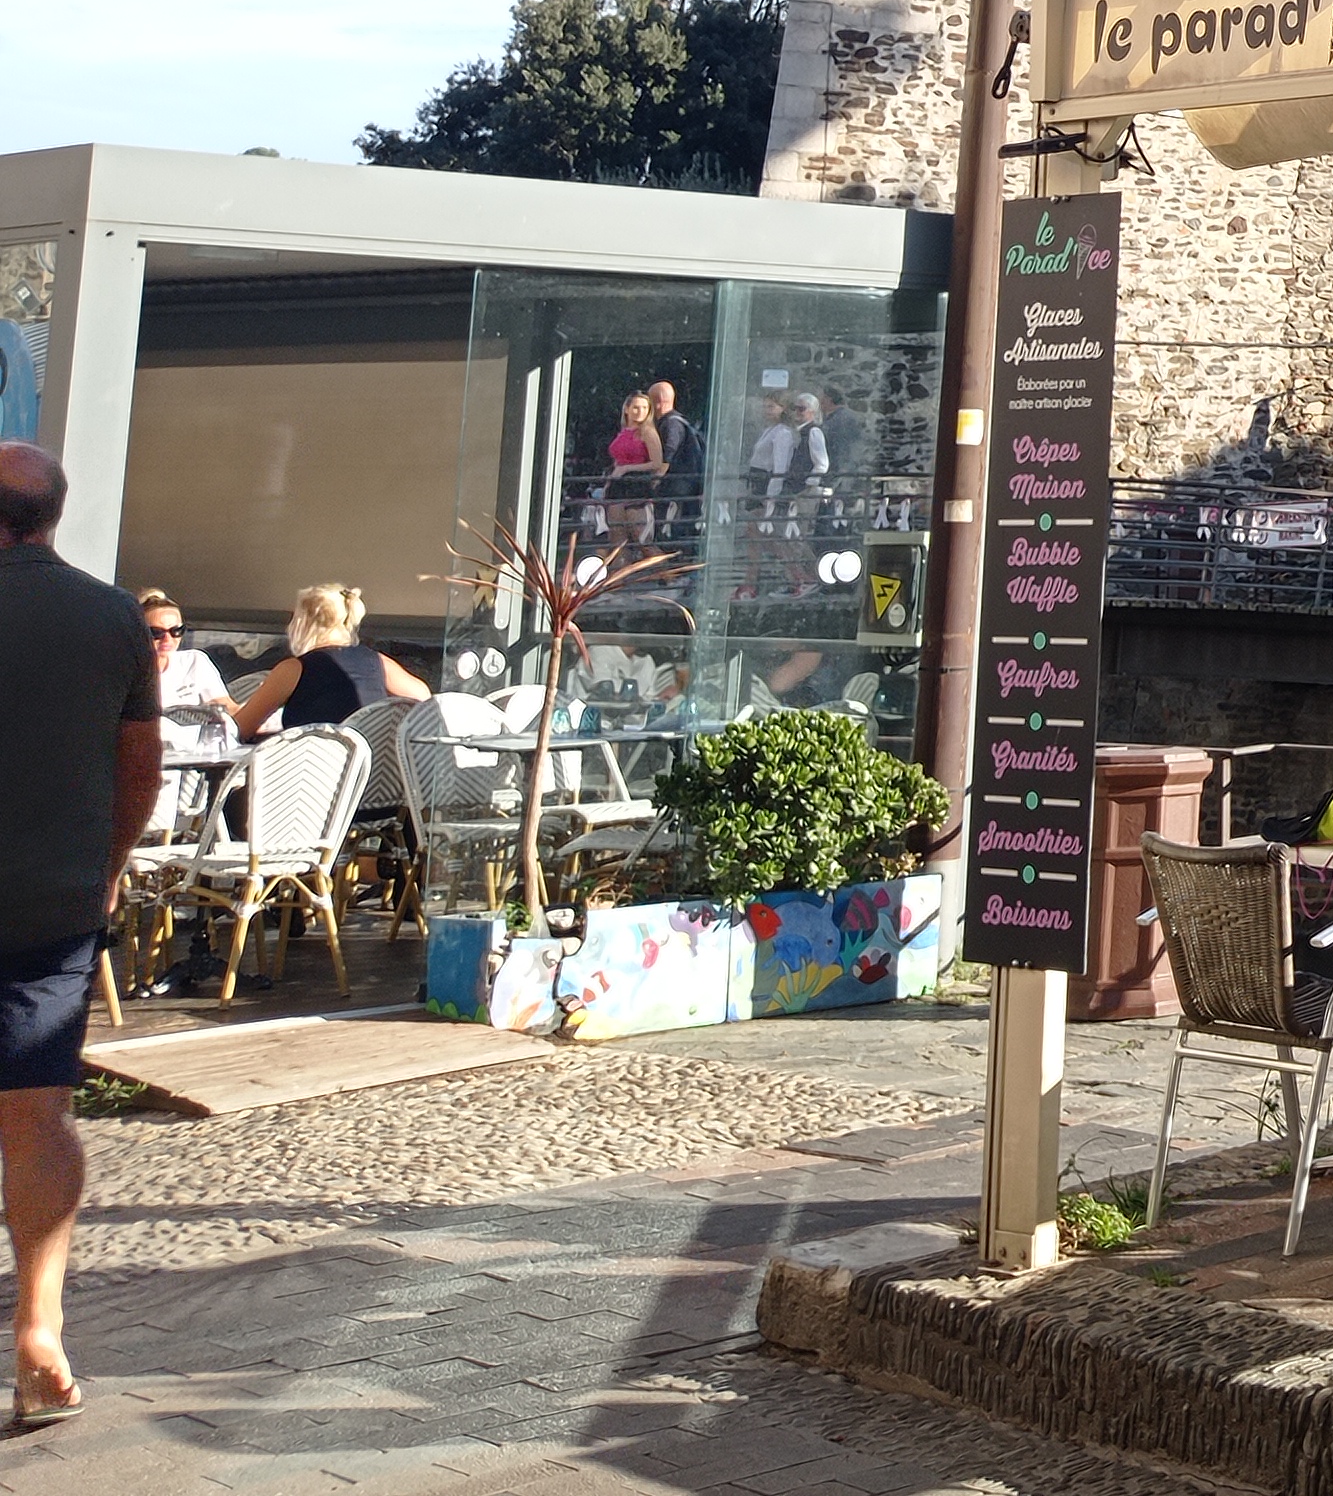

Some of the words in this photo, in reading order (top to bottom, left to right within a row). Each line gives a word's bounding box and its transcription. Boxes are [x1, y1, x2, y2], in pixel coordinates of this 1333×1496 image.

[1094, 0, 1132, 64] le
[1035, 210, 1055, 246] le
[1024, 302, 1084, 337] Glaces
[1004, 336, 1104, 365] Artisanales
[1017, 375, 1058, 391] Élaborées
[1059, 379, 1074, 391] par
[1075, 378, 1086, 389] un
[1035, 396, 1063, 410] artisan
[1064, 395, 1093, 411] glacier
[1013, 435, 1081, 468] Crêpes
[1009, 474, 1086, 505] Maison
[1007, 537, 1081, 567] Bubble
[1006, 576, 1079, 612] Waffle
[997, 658, 1079, 698] Gaufres
[991, 740, 1078, 780] Granités
[977, 820, 1084, 855] Smoothies
[981, 894, 1073, 931] Boissons
